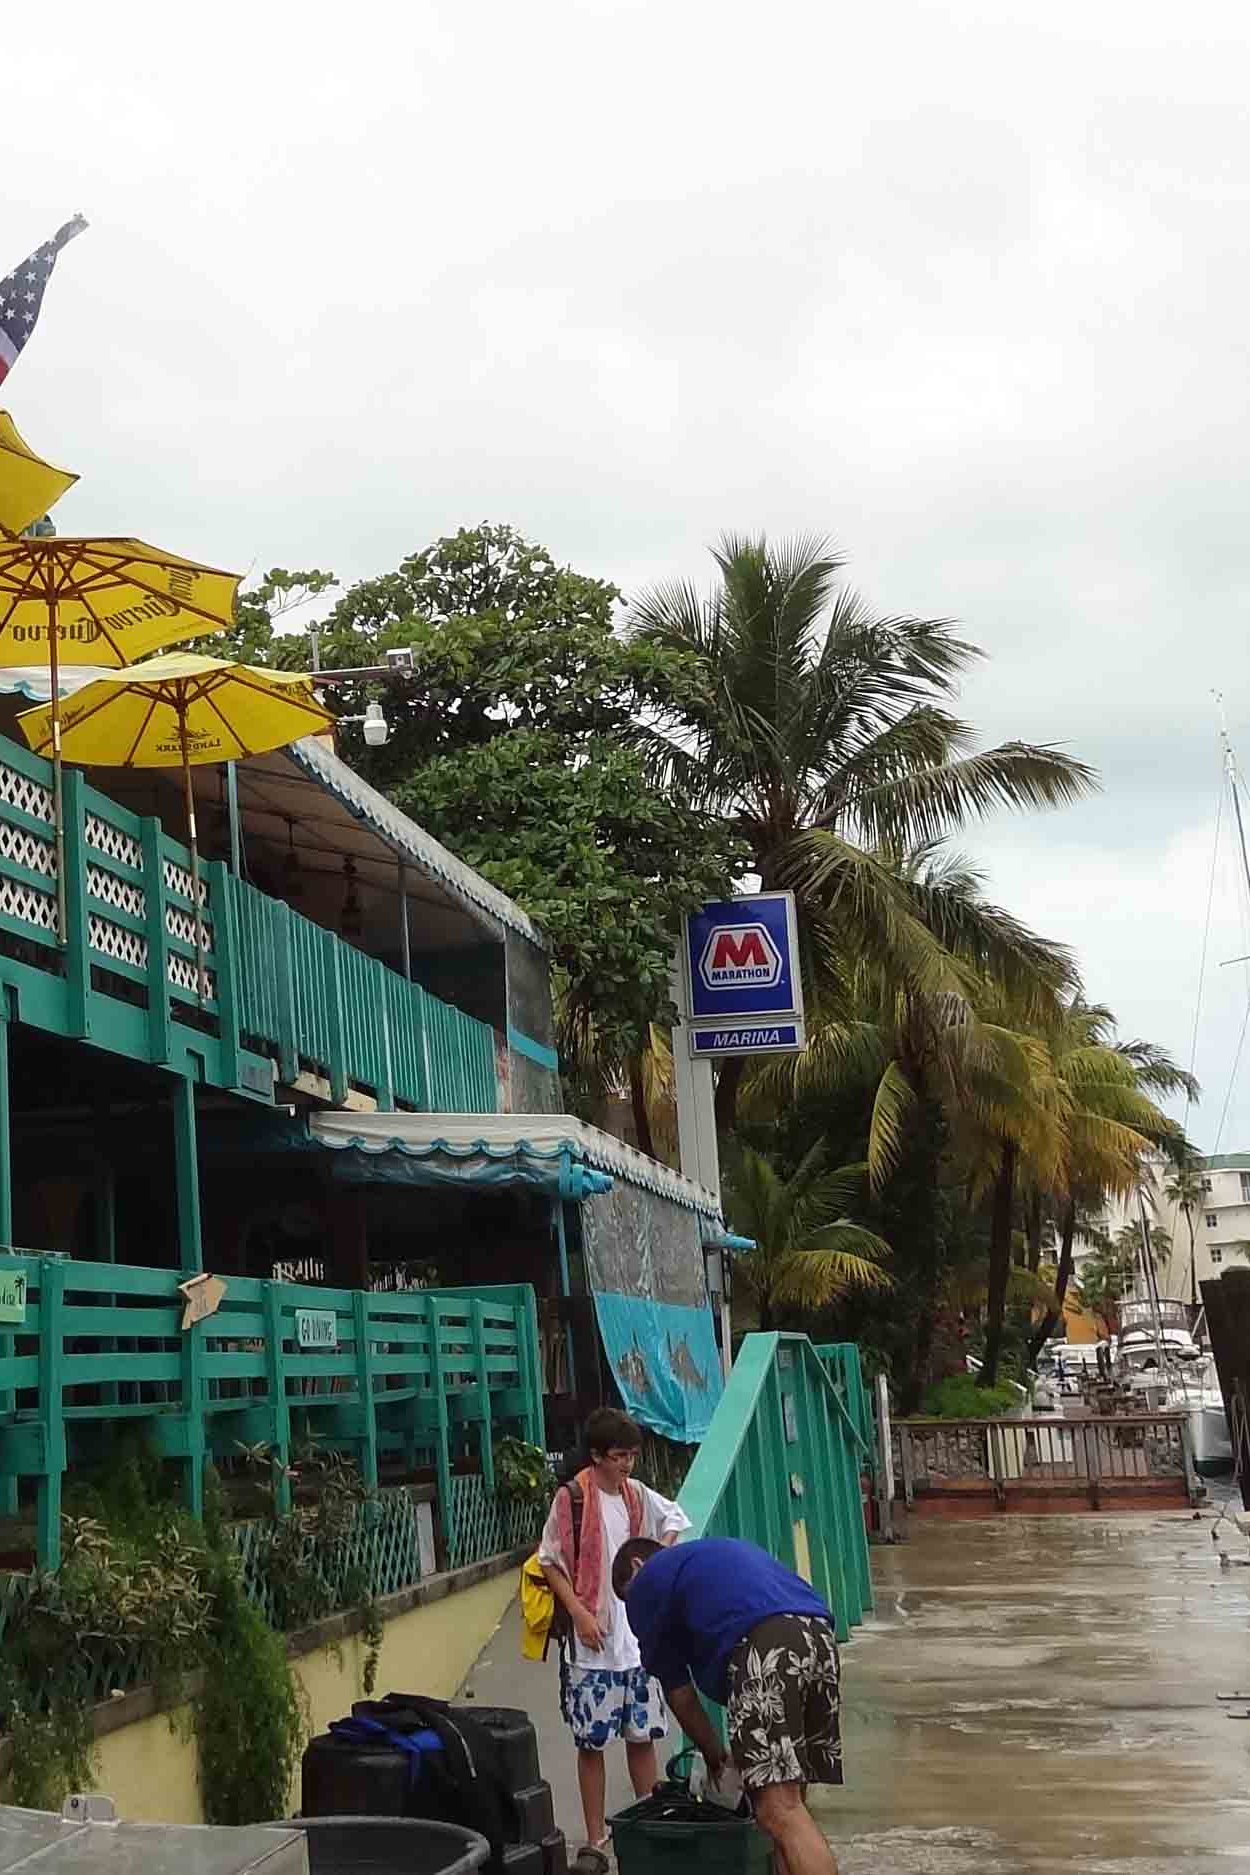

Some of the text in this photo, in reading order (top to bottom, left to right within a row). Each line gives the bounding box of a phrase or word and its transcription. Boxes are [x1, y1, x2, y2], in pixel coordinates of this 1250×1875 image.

[712, 933, 769, 968] M
[711, 967, 770, 982] MARATHON
[713, 1029, 781, 1047] MARINA
[301, 1317, 310, 1341] GO
